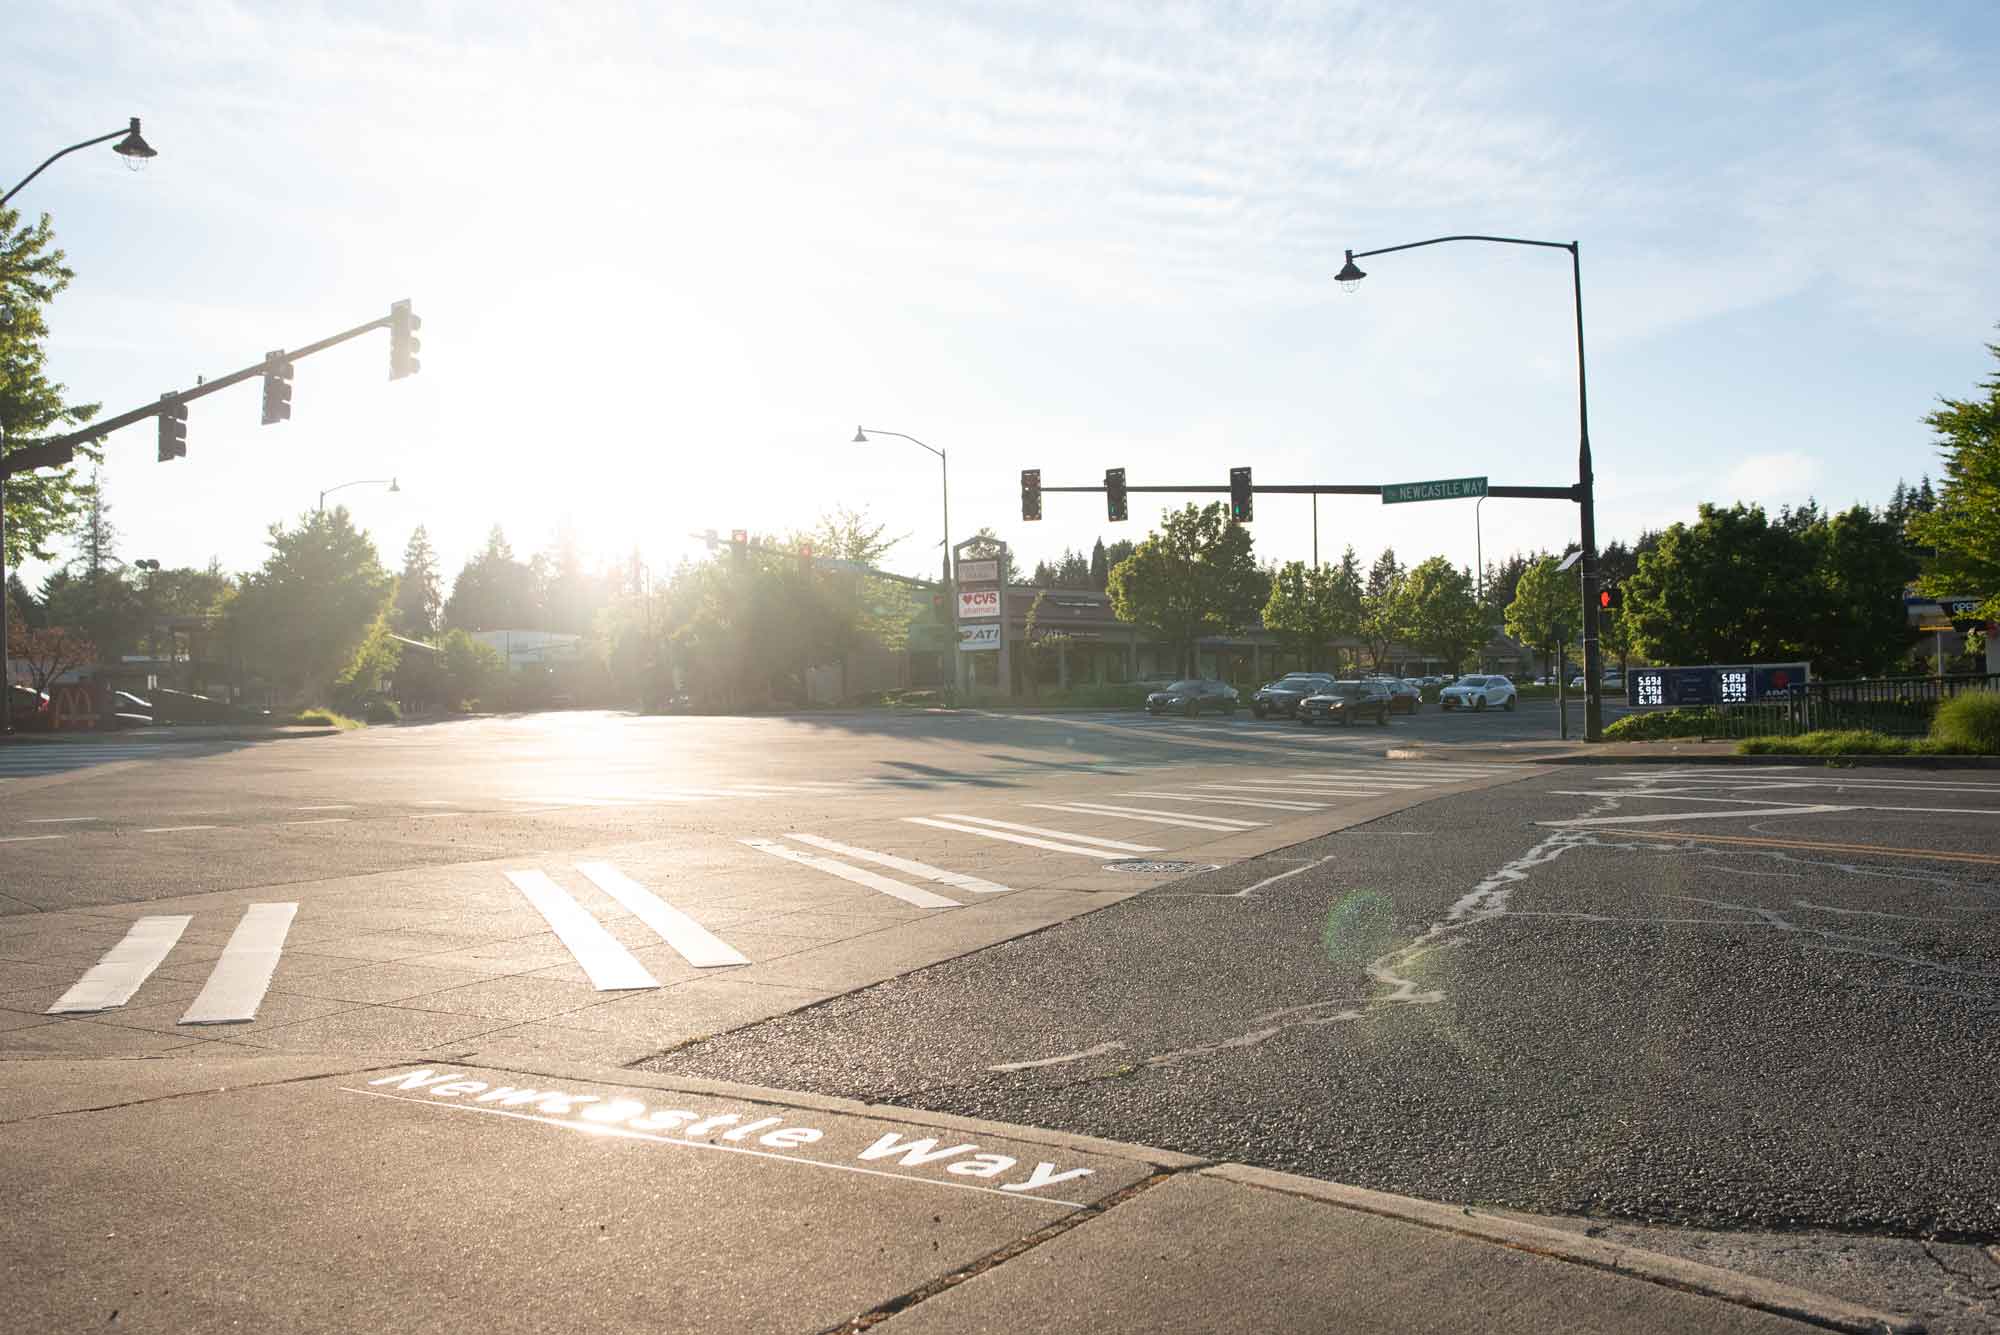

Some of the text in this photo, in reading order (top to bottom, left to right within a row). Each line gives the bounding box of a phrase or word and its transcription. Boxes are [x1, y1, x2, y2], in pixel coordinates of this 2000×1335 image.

[1400, 482, 1460, 500] NEWCASTLE
[1462, 479, 1484, 496] WAY
[973, 592, 997, 605] CVS
[975, 629, 999, 640] ATI
[856, 1132, 1095, 1193] Way
